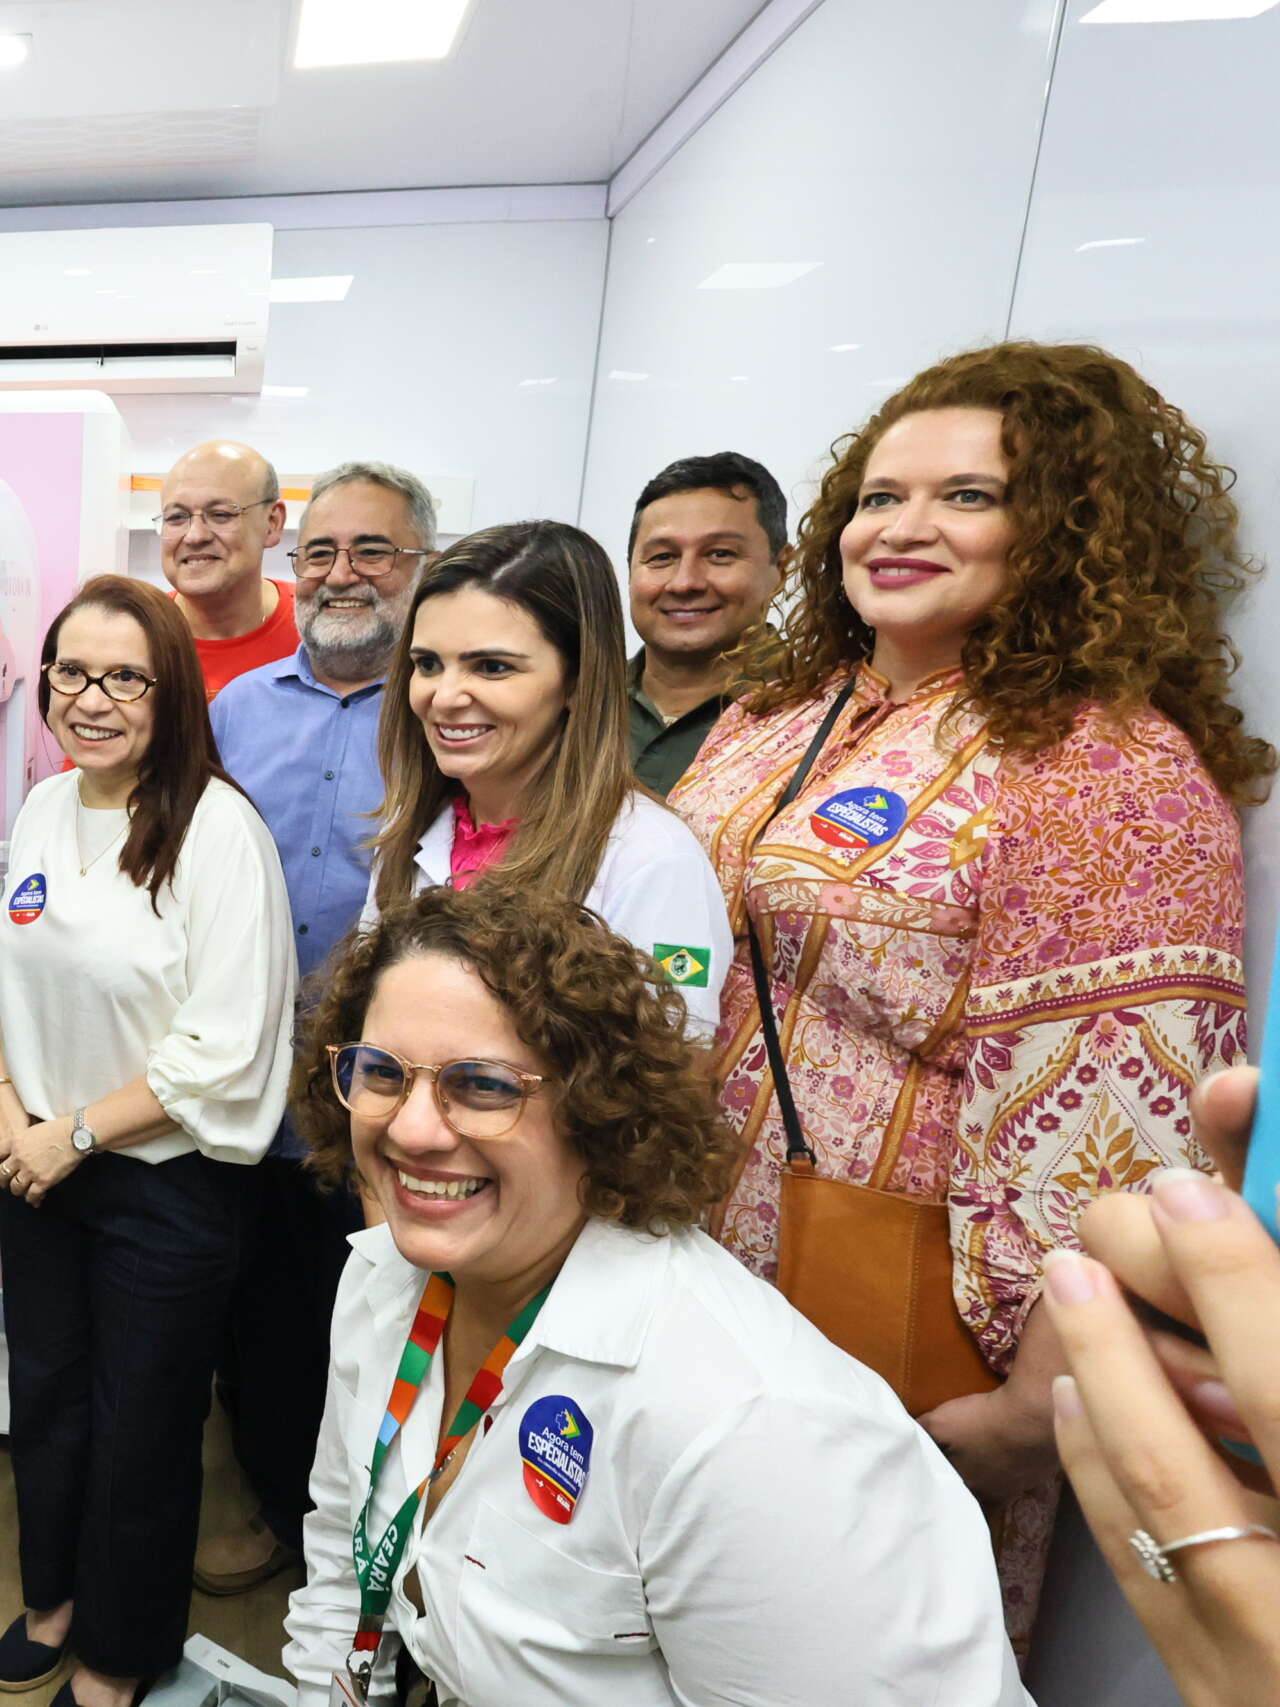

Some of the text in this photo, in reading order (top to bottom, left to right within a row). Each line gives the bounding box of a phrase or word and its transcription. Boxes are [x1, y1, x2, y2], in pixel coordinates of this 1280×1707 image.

[826, 802, 889, 837] ESPECIALISTAS
[845, 800, 888, 824] Agora tem
[542, 1427, 585, 1464] Agora tem
[366, 1523, 399, 1593] CEARÁ
